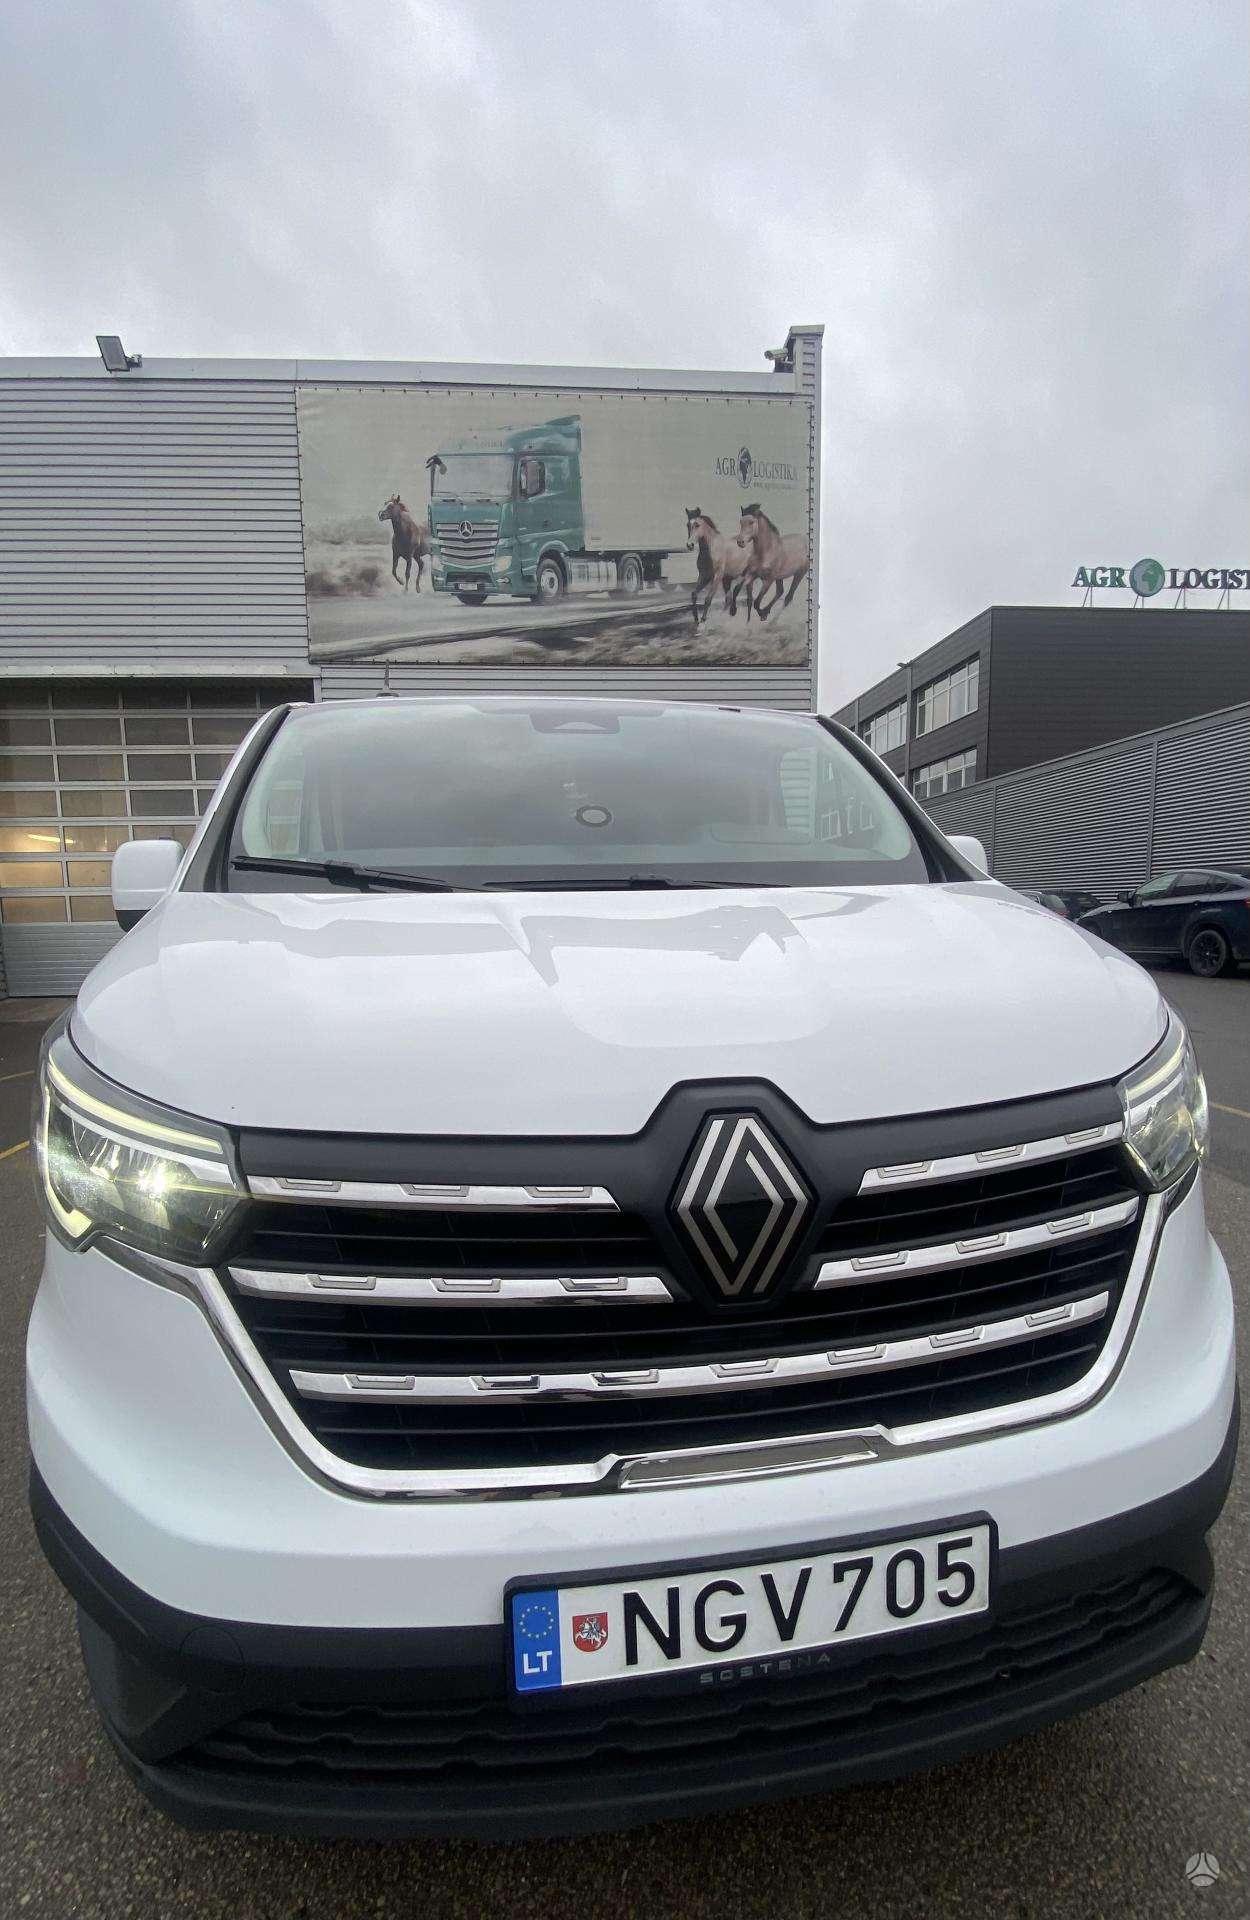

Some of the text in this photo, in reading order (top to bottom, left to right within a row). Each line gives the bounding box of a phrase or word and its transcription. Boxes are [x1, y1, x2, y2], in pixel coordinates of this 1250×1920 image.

[623, 1536, 975, 1666] NGV 705
[523, 1650, 553, 1674] LT
